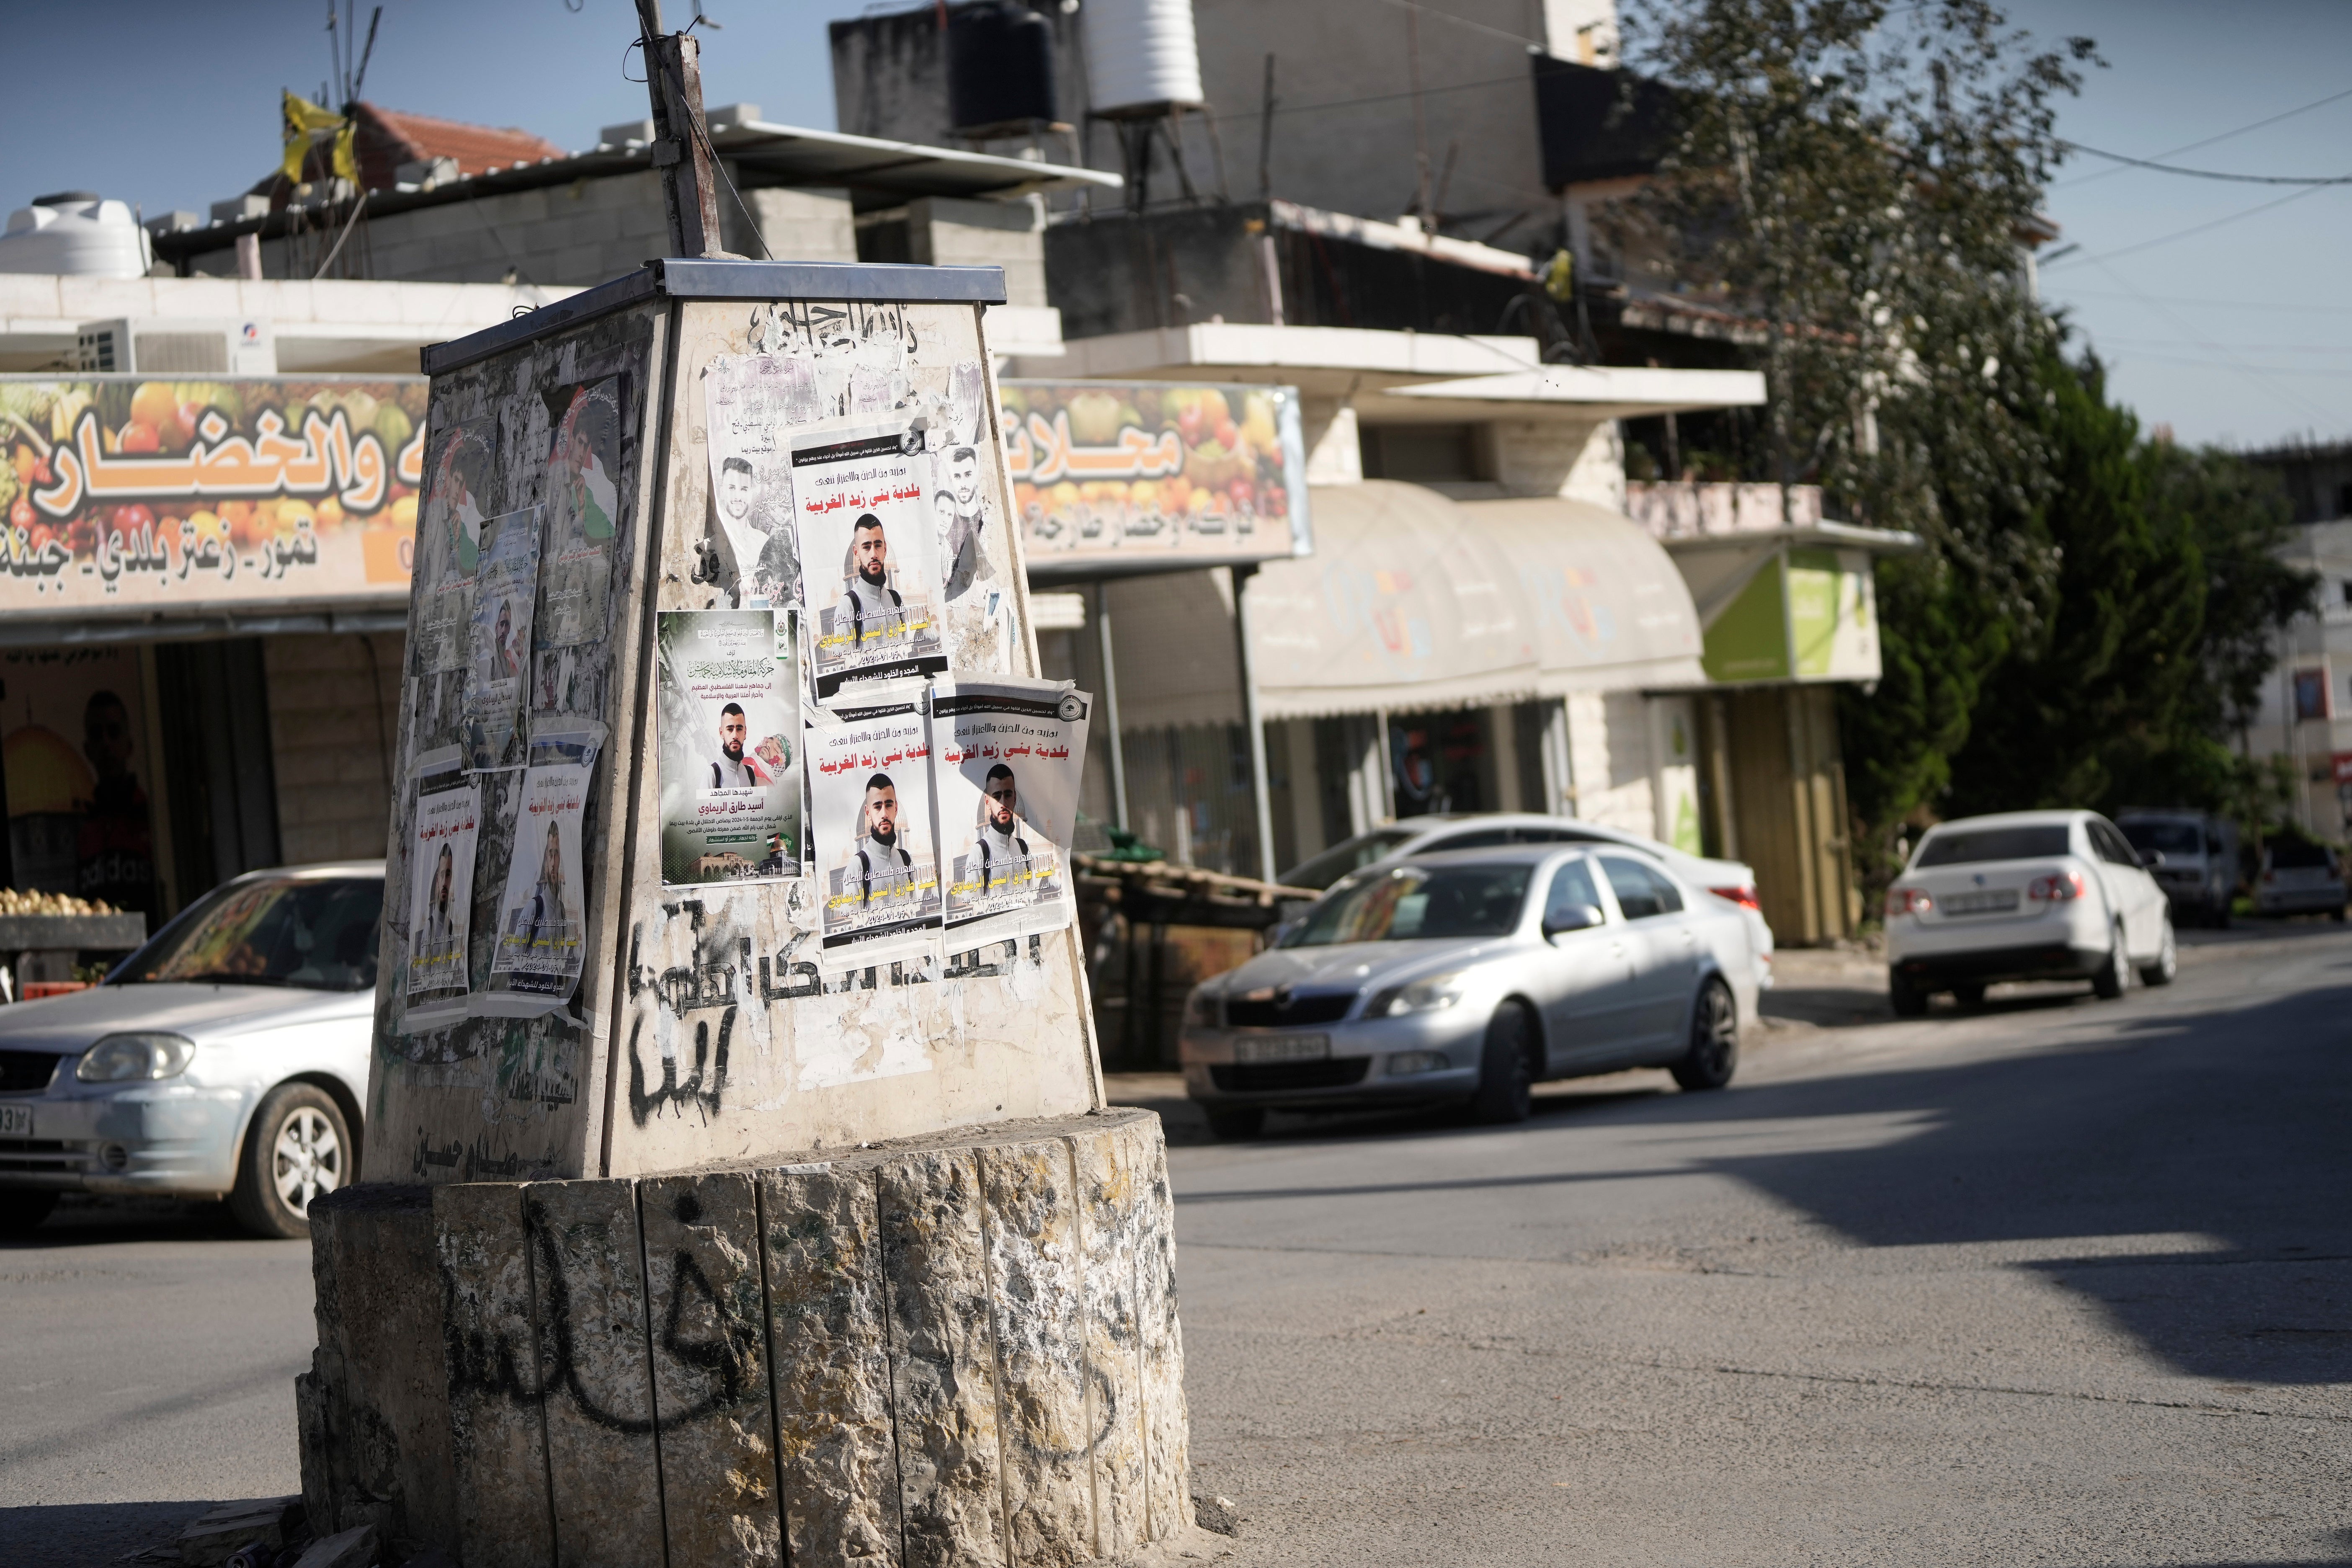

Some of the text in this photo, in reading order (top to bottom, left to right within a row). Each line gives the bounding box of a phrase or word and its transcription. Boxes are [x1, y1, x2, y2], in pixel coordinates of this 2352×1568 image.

[32, 408, 387, 517] والخضار
[861, 468, 876, 480] الحزن
[879, 469, 887, 477] من
[889, 467, 905, 476] بمزيد
[806, 482, 920, 515] بلدية بني زيد الغربية
[260, 519, 318, 580] تمور
[97, 520, 169, 594] بلدي
[835, 611, 855, 626] البطل
[856, 607, 886, 621] فلسطين
[887, 620, 907, 638] طارق
[819, 627, 856, 652] الريماوي
[861, 651, 898, 664] 2024-01-05
[884, 669, 898, 679] الخلود
[904, 665, 918, 676] المجد
[873, 728, 890, 740] الحزن
[892, 728, 900, 737] من
[903, 725, 918, 735] بمزيد
[998, 723, 1019, 734] الحزن
[1022, 725, 1034, 735] من
[1037, 728, 1058, 738] بمزيد
[820, 741, 931, 776] بلدية بني زيد الغربية
[945, 741, 1069, 765] بلدية بني زيد الغربية
[710, 788, 753, 798] شهيدها المجاهد
[529, 796, 547, 816] الغربية
[698, 798, 763, 817] أسيد طارق الريماوي
[894, 879, 915, 897] طارق
[828, 887, 864, 912] الريماوي
[868, 910, 905, 924] 2024-01-05
